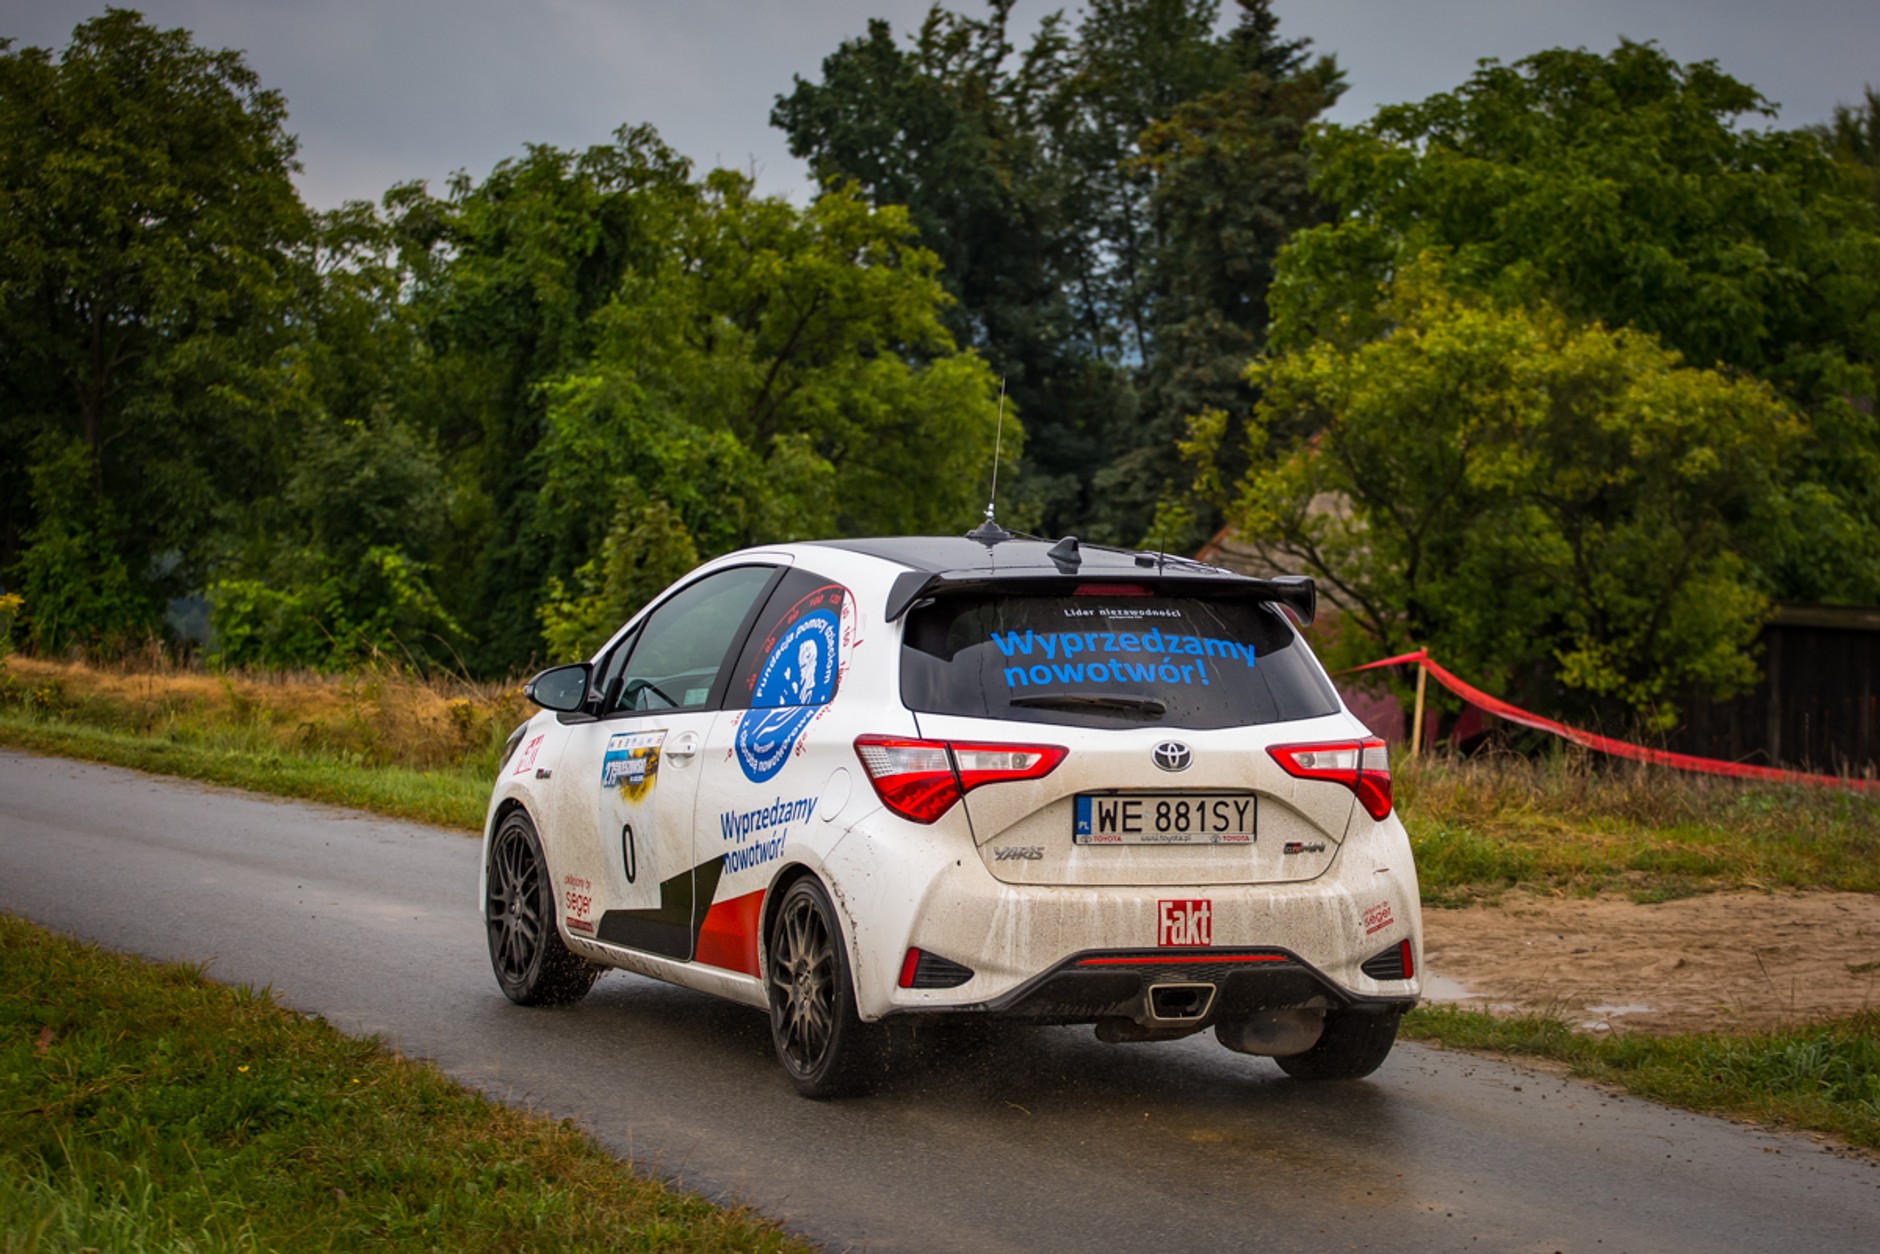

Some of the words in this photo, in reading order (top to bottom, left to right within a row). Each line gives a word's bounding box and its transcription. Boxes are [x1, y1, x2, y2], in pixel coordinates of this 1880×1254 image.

[1064, 608, 1095, 617] Lider
[757, 631, 794, 697] Fundacja
[991, 627, 1255, 668] Wyprzedzamy
[1003, 656, 1210, 688] nowotwór!
[720, 796, 818, 844] Wyprzedzamy
[1078, 821, 1090, 830] PL
[1098, 800, 1142, 833] WE
[1155, 800, 1250, 833] 881SY
[622, 823, 636, 884] 0
[723, 828, 788, 875] nowotwór!
[1223, 834, 1250, 842] TOYOTA
[565, 891, 592, 917] seger
[1364, 906, 1391, 928] seger
[1160, 900, 1211, 946] Fakt
